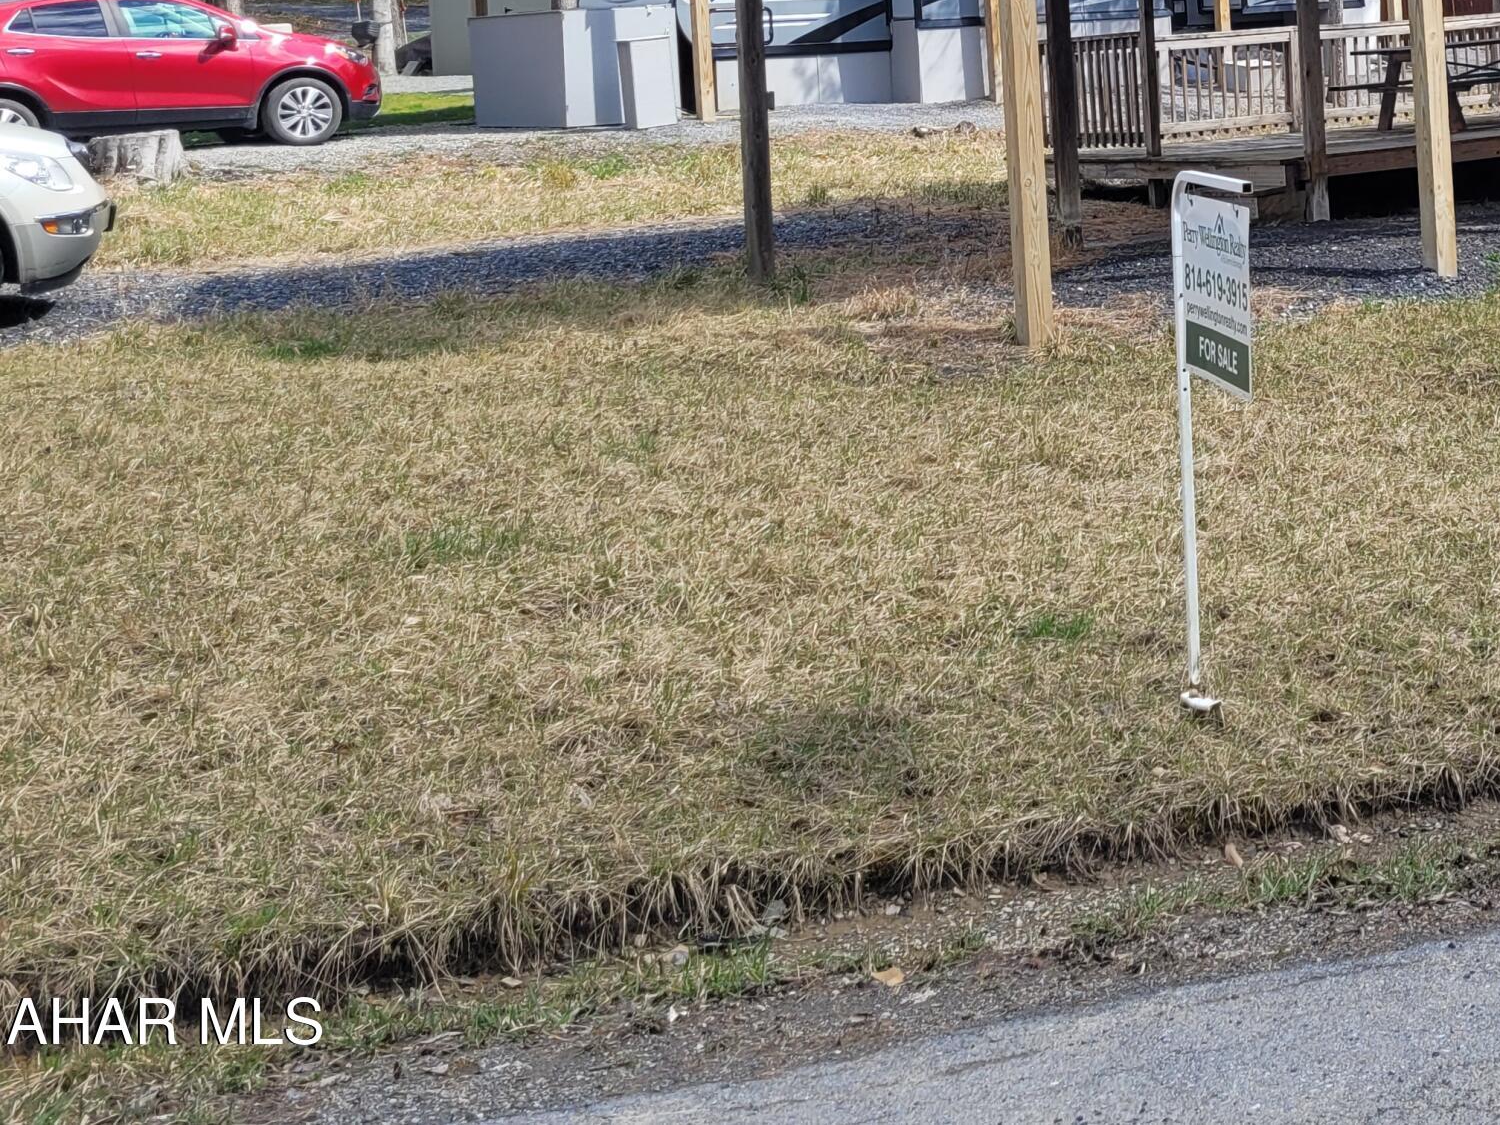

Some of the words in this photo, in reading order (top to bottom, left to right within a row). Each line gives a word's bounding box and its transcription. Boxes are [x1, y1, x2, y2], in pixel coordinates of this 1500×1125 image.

[1182, 221, 1198, 249] Perry
[1229, 233, 1247, 265] Realty
[1184, 262, 1248, 312] 814-619-3915
[1199, 336, 1216, 364] FOR
[1217, 344, 1238, 375] SALE
